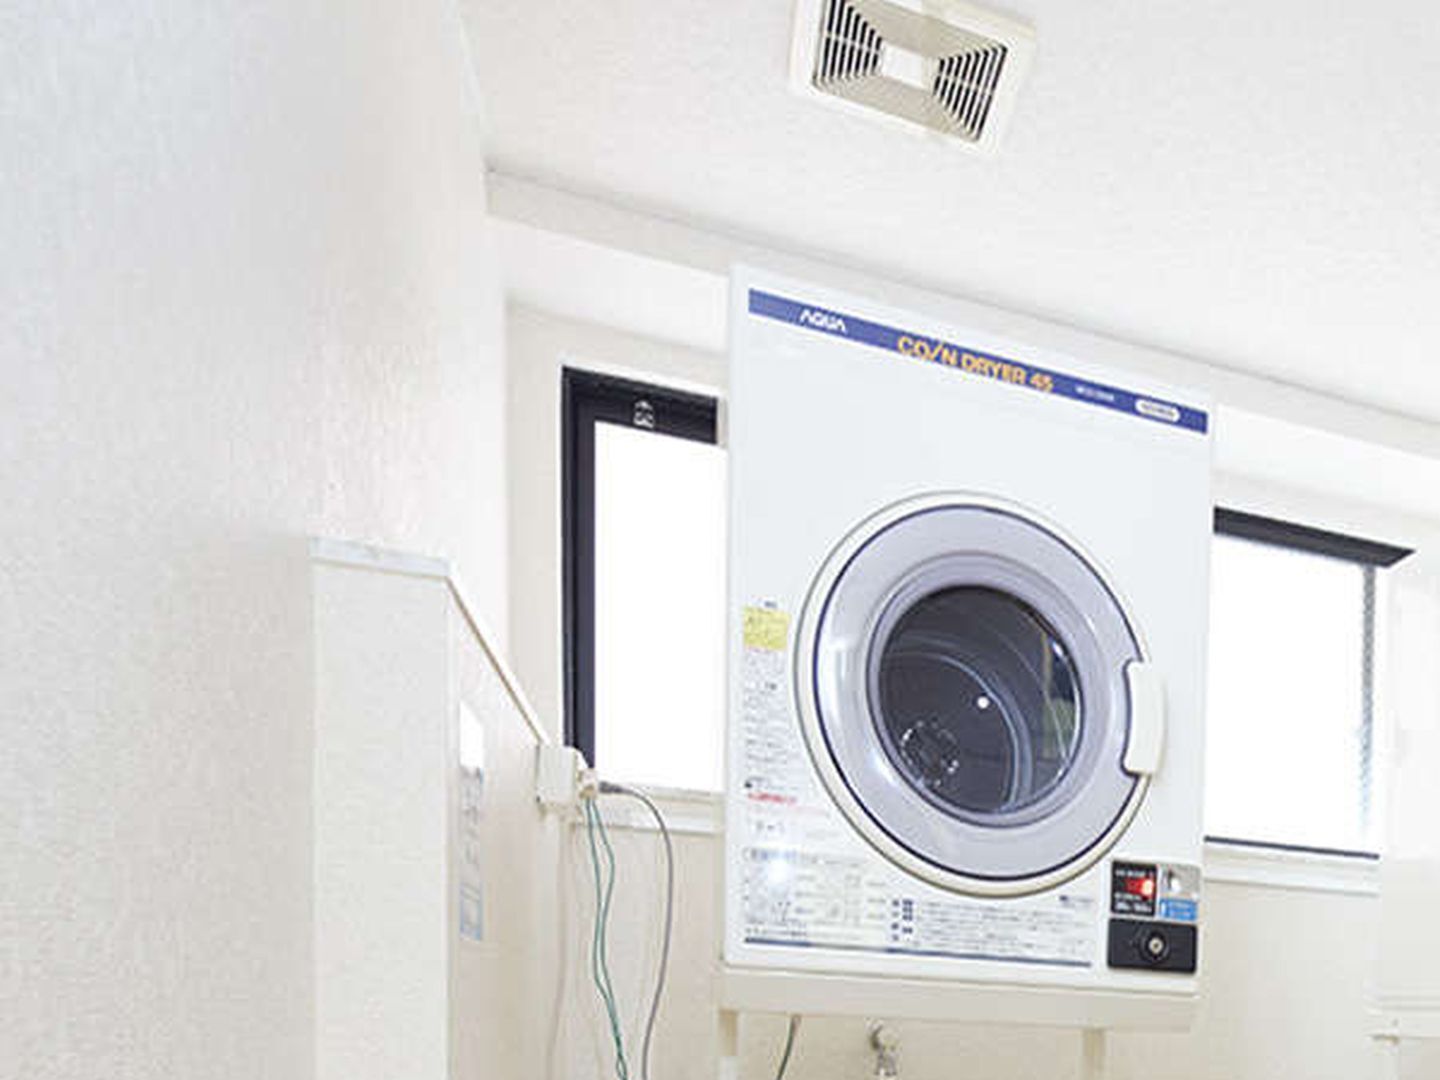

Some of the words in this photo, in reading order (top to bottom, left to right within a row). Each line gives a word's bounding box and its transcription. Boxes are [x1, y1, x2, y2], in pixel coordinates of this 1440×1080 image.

[800, 309, 847, 334] AQUA
[961, 354, 1026, 384] DRYER
[1030, 372, 1054, 393] 45
